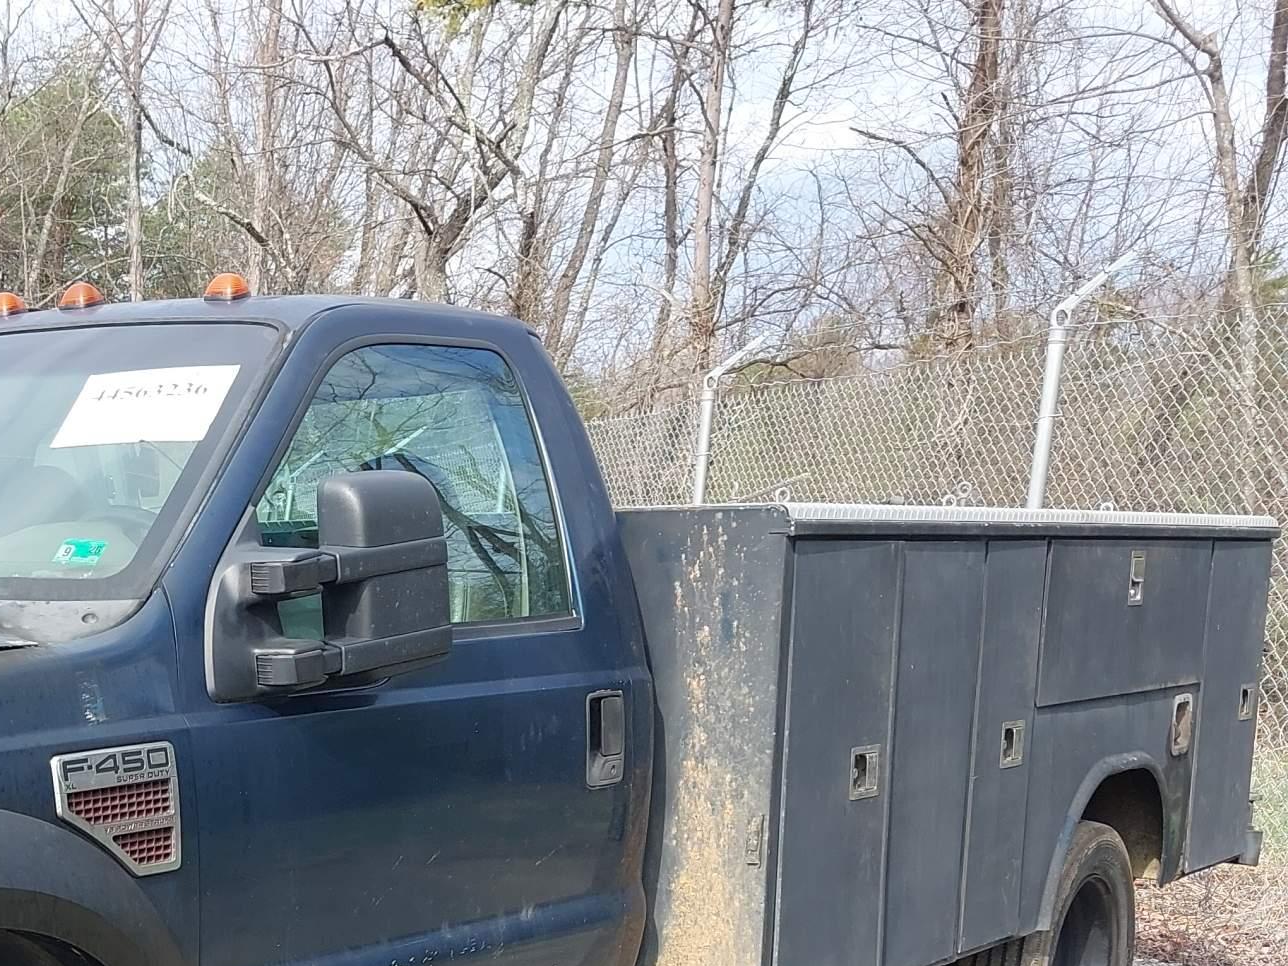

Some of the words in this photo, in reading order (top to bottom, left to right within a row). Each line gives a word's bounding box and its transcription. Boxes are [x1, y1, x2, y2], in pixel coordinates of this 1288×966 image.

[91, 381, 210, 402] 44563236
[61, 546, 73, 557] 9
[62, 747, 171, 782] F-450
[116, 772, 145, 783] SUPER
[147, 769, 171, 779] DUTY
[65, 782, 77, 791] XL
